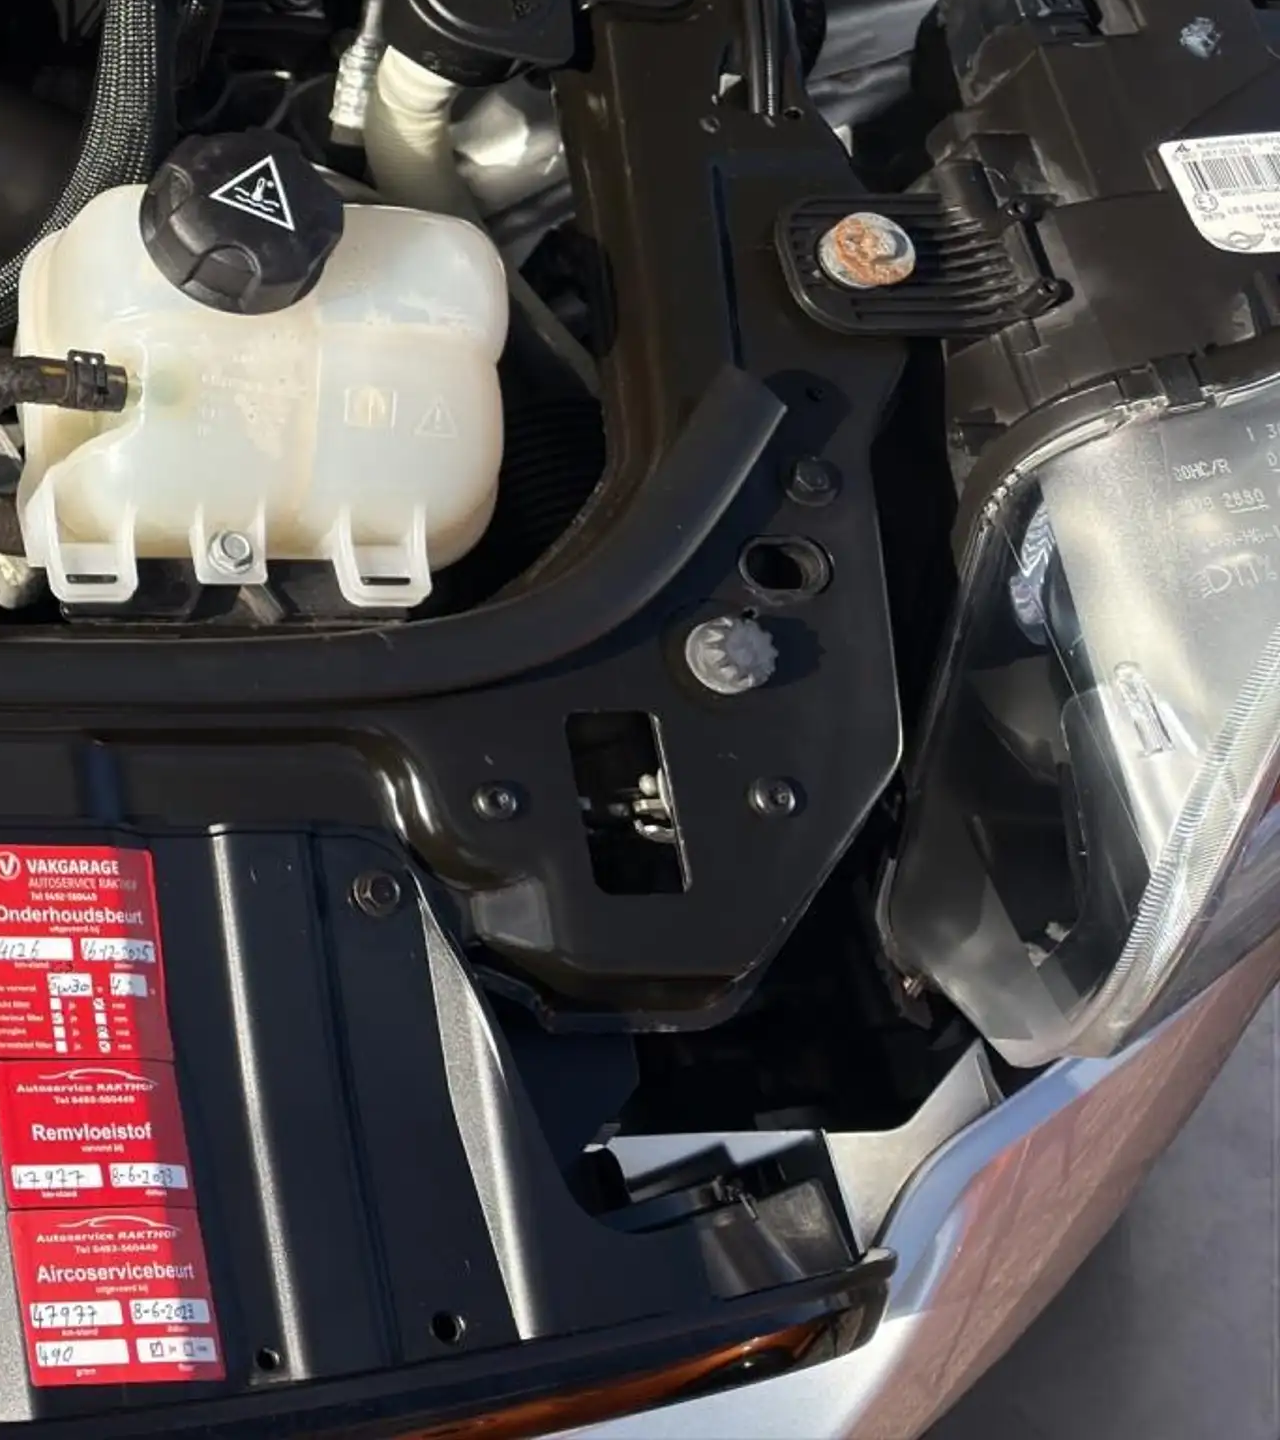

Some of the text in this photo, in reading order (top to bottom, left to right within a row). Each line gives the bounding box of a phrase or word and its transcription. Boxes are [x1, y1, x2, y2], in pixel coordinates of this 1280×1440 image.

[26, 858, 120, 875] VAKGARAGE
[28, 877, 95, 889] AUTOSERVICE
[16, 1083, 93, 1094] Autoservice
[53, 1095, 70, 1104] Tel
[31, 1122, 153, 1142] Remvloeistof
[36, 1231, 114, 1243] Autoservice
[74, 1244, 91, 1254] Tel
[36, 1261, 195, 1284] Aircoservicebeurt
[32, 1304, 98, 1328] 47977
[39, 1345, 74, 1365] 490
